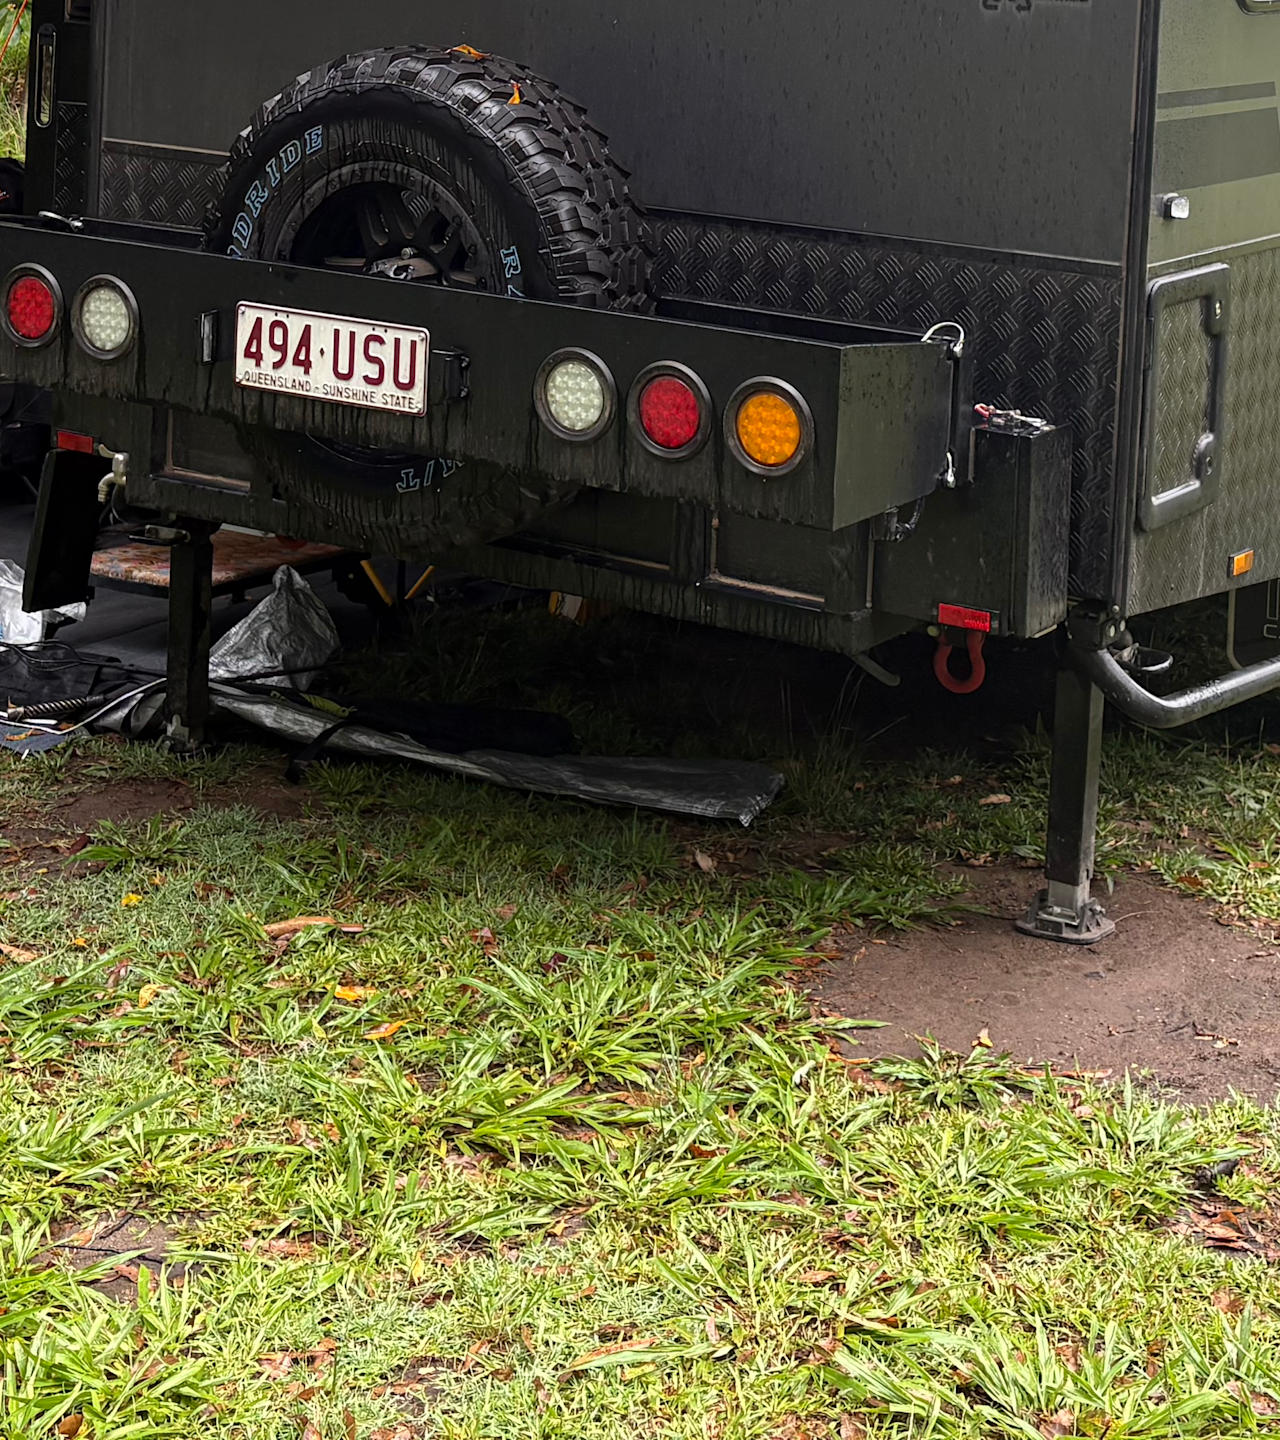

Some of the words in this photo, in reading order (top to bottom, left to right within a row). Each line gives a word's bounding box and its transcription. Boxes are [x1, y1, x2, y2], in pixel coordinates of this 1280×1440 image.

[243, 370, 311, 392] QUEENSLAND
[322, 384, 377, 404] SUNSHINE
[382, 393, 415, 410] STATE
